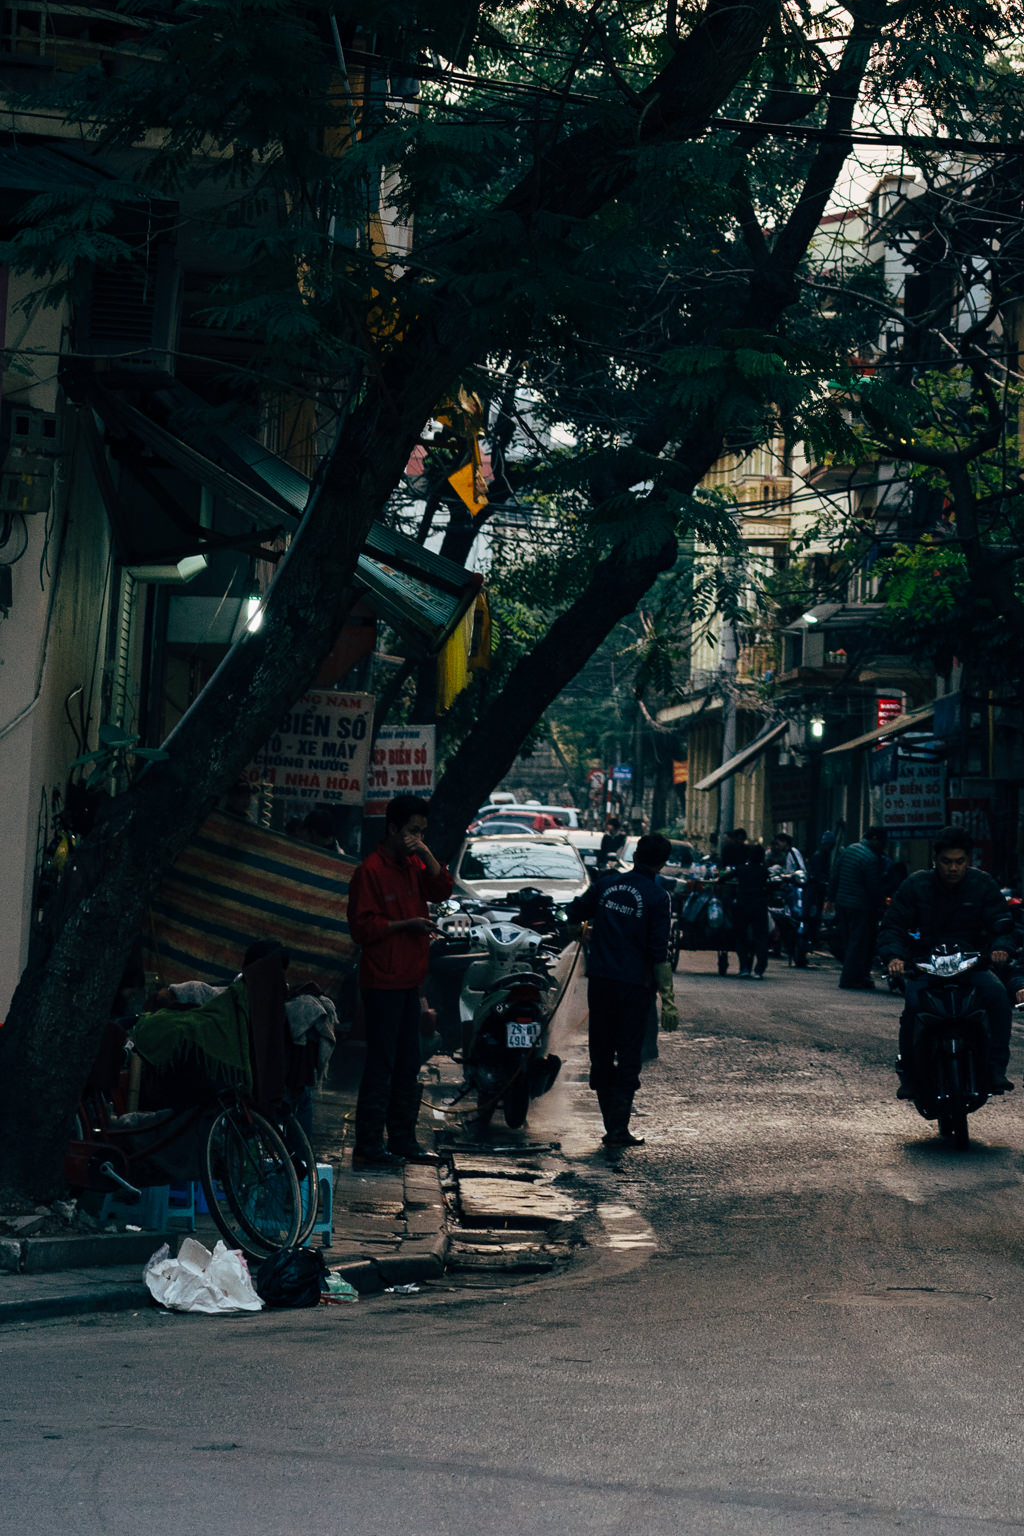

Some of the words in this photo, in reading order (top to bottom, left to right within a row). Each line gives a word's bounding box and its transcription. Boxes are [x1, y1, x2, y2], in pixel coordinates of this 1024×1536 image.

[326, 695, 362, 710] NAM
[278, 705, 331, 738] BIỂN
[336, 710, 369, 741] SỐ
[297, 740, 318, 758] XE
[322, 739, 358, 761] MÁY
[389, 741, 413, 765] BIỂN
[414, 741, 428, 765] SỐ
[285, 772, 321, 790] NHÀ
[396, 769, 410, 787] XE
[411, 764, 433, 787] MÁY
[925, 780, 942, 795] SỐ
